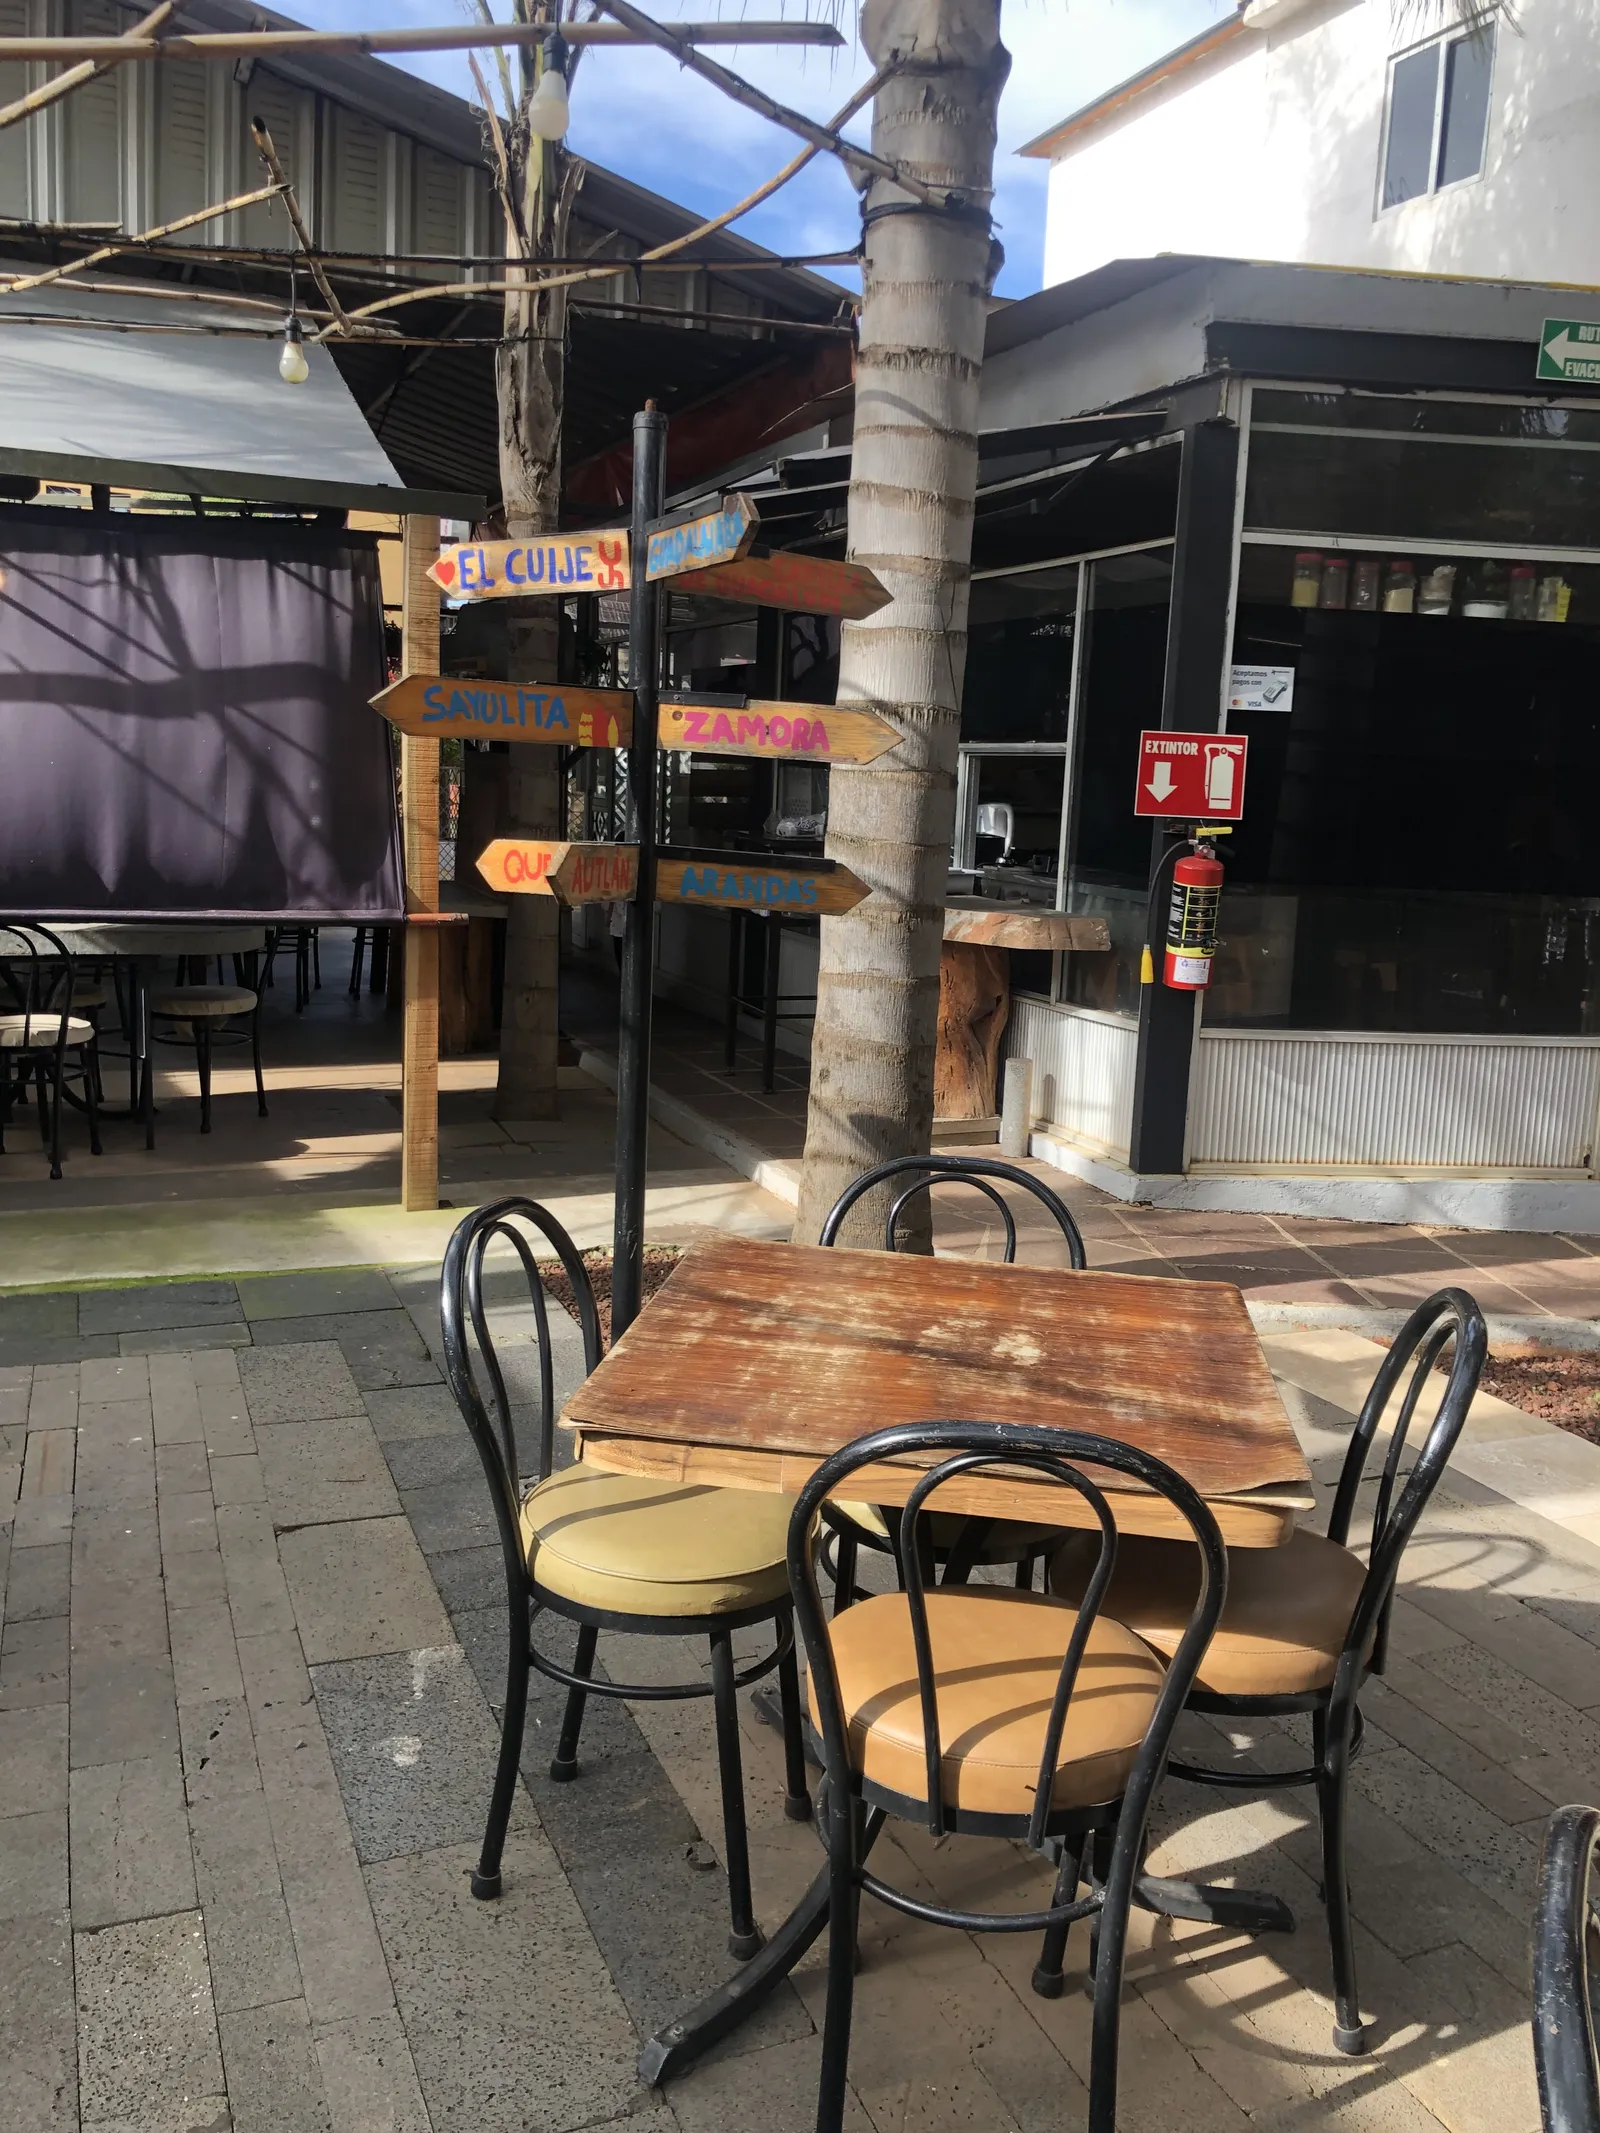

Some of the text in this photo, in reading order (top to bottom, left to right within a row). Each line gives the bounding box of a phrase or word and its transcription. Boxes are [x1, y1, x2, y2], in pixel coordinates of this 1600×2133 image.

[458, 545, 593, 590] EL CUIJE
[422, 684, 569, 729] SAYULITA
[683, 711, 830, 752] ZAMORA
[1145, 740, 1198, 755] EXTINTOR
[680, 865, 819, 905] ARANDAS
